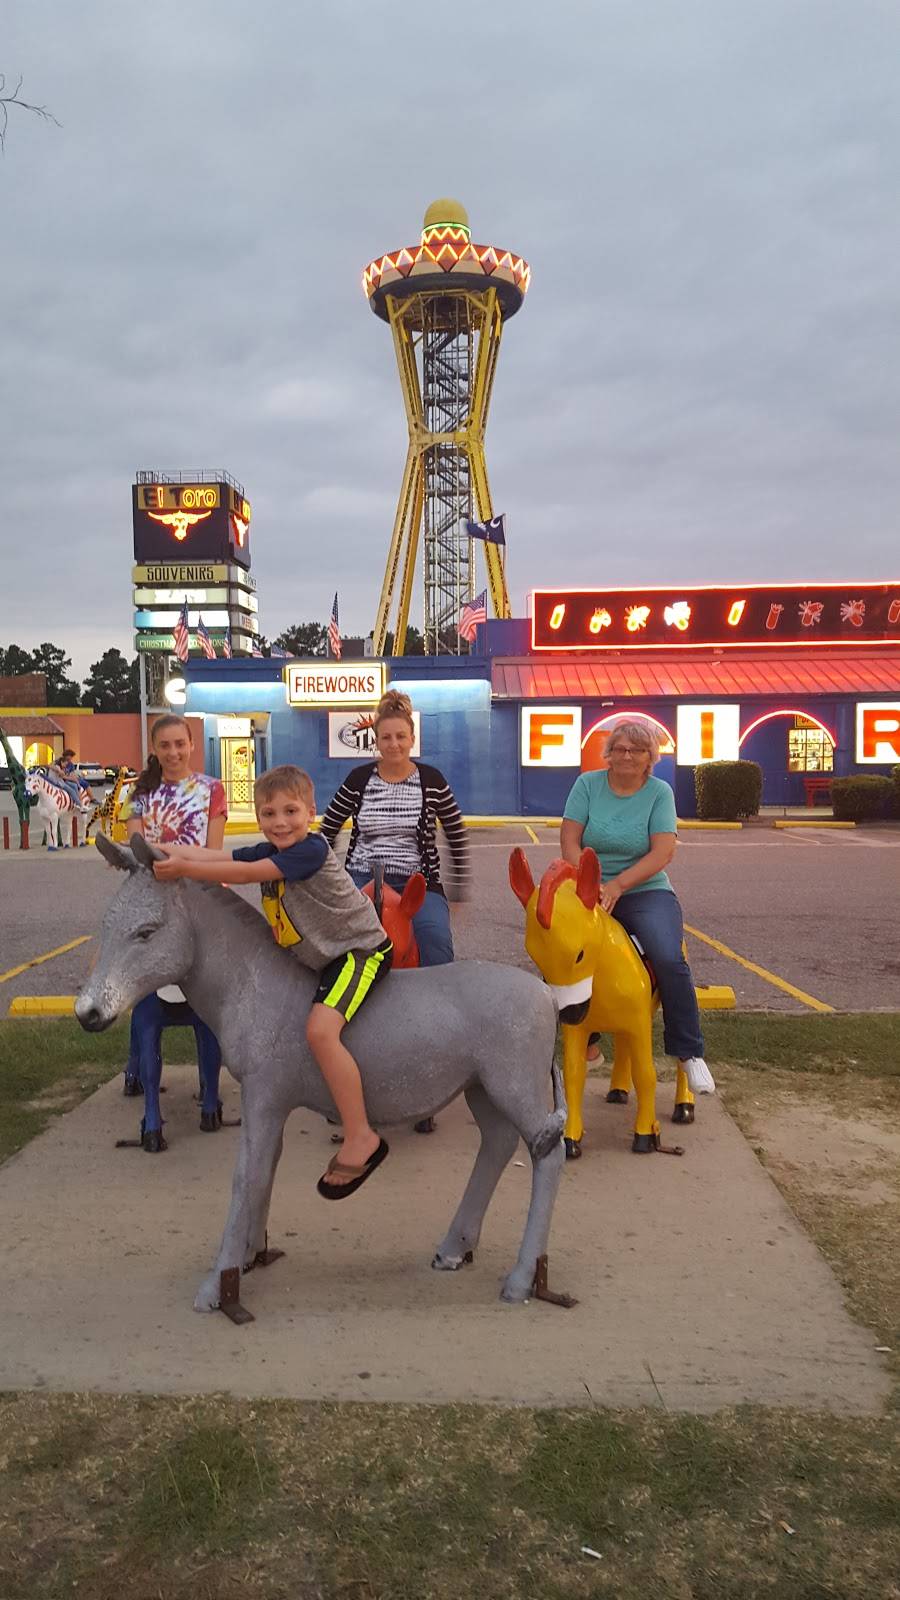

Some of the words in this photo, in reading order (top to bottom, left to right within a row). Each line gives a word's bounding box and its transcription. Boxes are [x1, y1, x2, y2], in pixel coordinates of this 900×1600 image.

[143, 487, 164, 508] El
[169, 486, 217, 508] Toro
[147, 567, 214, 581] SOUVENIRS
[295, 676, 375, 693] FIREWORKS
